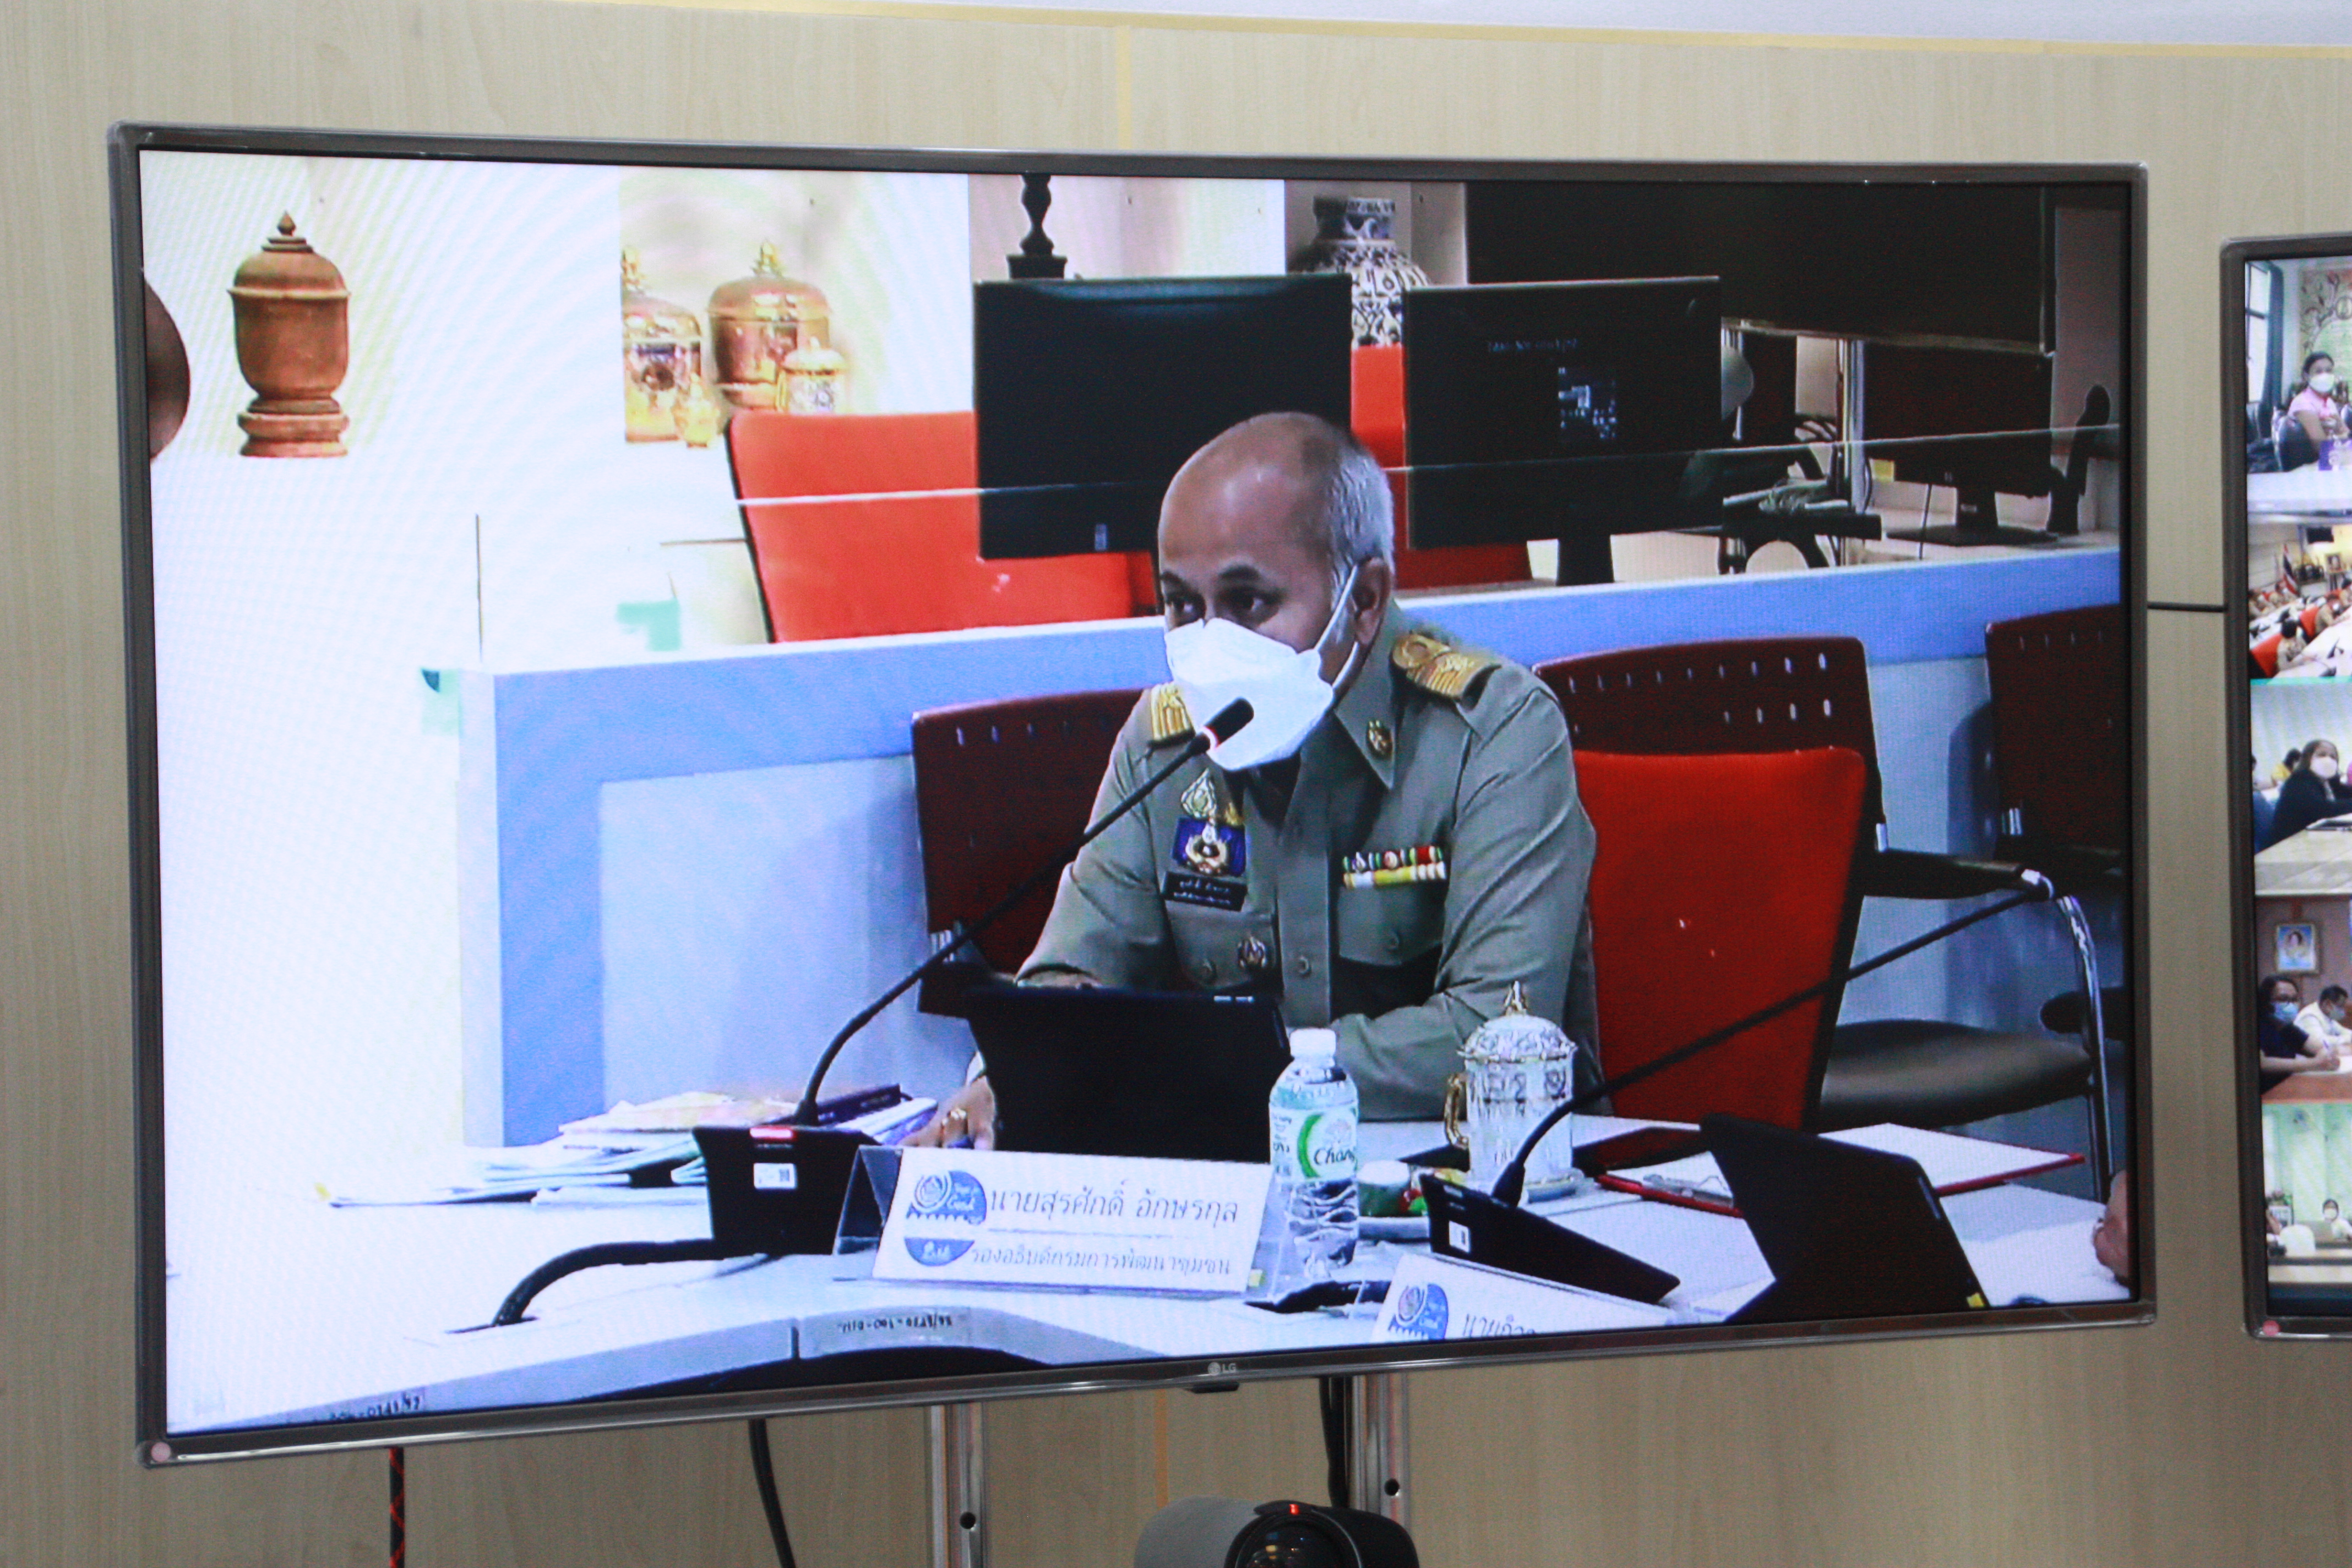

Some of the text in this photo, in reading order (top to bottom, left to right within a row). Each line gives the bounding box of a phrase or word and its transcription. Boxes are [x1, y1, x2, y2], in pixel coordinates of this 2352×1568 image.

[991, 1179, 1237, 1228] นายสุรศักดิ์ อักษรกุล
[1222, 1363, 1237, 1374] LG
